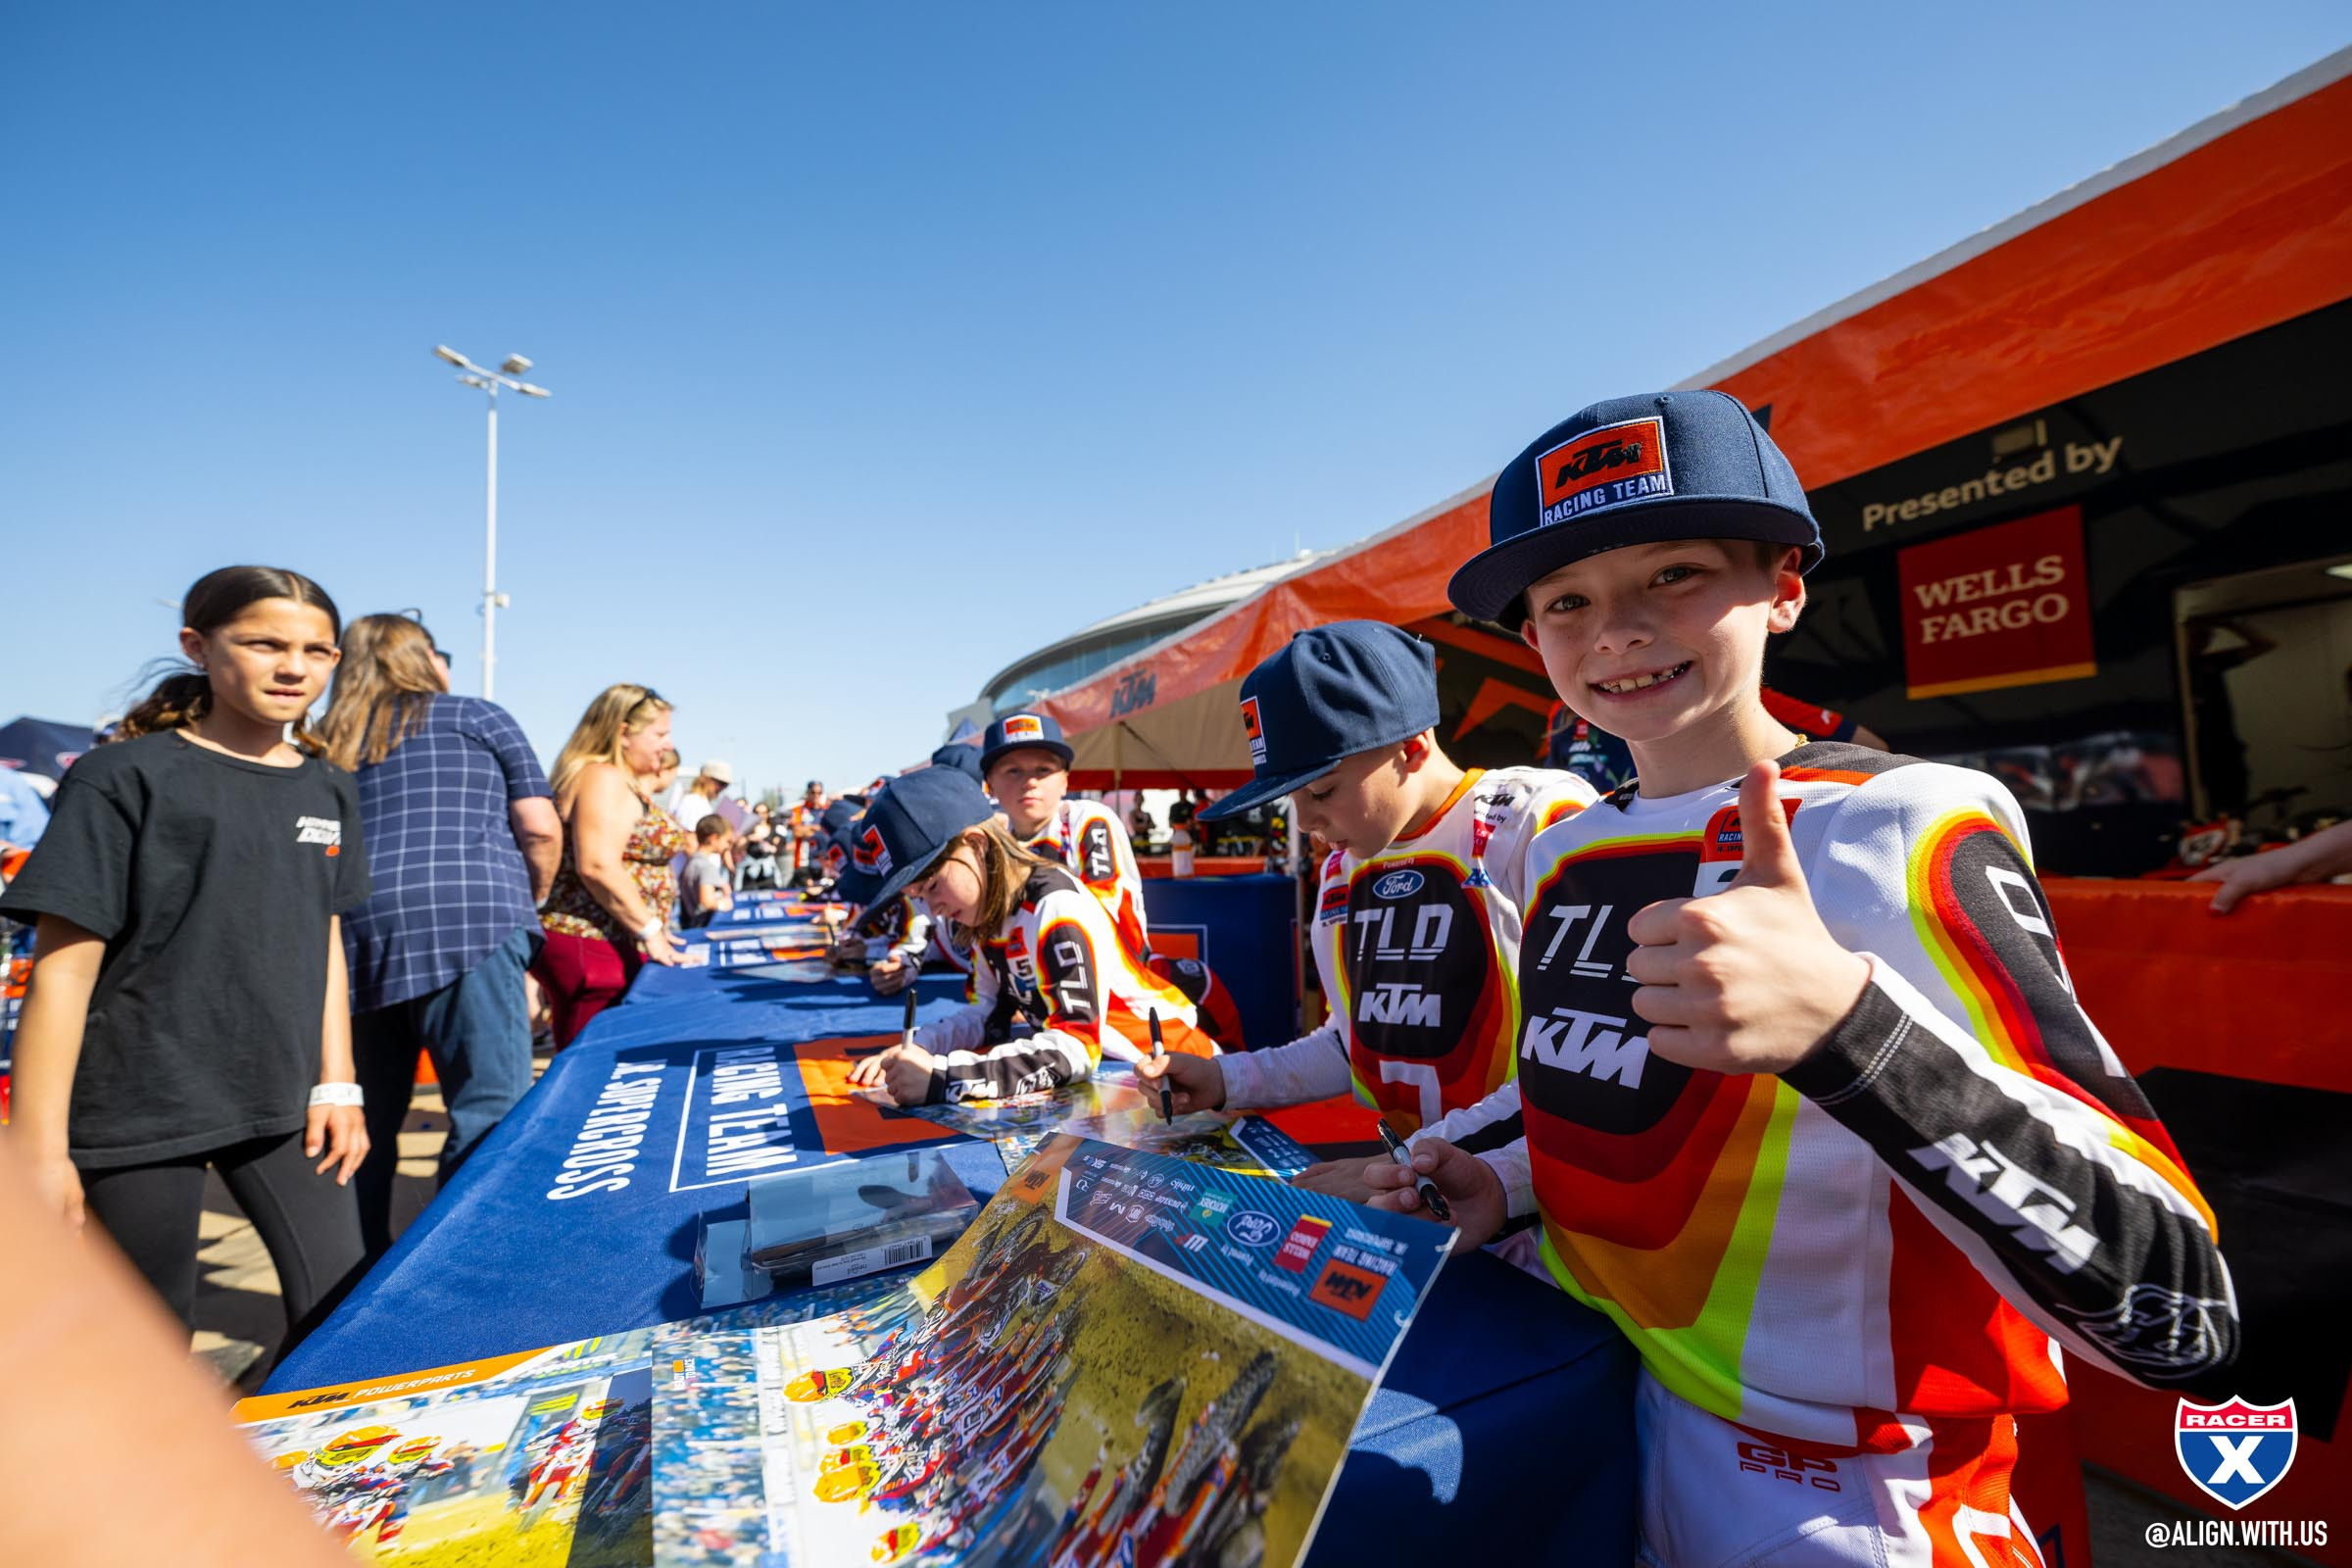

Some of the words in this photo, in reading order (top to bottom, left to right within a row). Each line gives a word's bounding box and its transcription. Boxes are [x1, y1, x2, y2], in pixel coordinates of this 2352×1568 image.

[1555, 439, 1642, 489] KTM
[1862, 448, 2055, 531] Presented
[2064, 436, 2124, 474] by
[1544, 488, 1606, 526] RACING
[1612, 474, 1666, 500] TEAM
[1914, 555, 2065, 611] WELLS
[1920, 592, 2070, 645] FARGO
[1108, 668, 1156, 719] KTM
[1718, 832, 1743, 843] RACIN
[1382, 873, 1414, 896] Ford
[1353, 903, 1454, 962] TLD
[1537, 904, 1641, 983] TL
[1015, 957, 1033, 977] 5
[1054, 939, 1093, 1015] TLD
[1358, 983, 1443, 1029] KTM
[1520, 1006, 1651, 1090] KTM
[710, 1046, 783, 1105] RACING
[546, 1076, 663, 1200] SUPERCROSS
[706, 1102, 799, 1177] TEAM
[1234, 1214, 1273, 1243] Ford
[1907, 1132, 2100, 1277] KTM
[1282, 1243, 1312, 1261] WELLS
[1332, 1244, 1358, 1265] TEAM
[1355, 1250, 1398, 1277] RACING
[1324, 1270, 1372, 1302] KTM
[286, 1392, 350, 1409] KTM
[353, 1369, 477, 1399] POWERPARTS
[684, 1358, 696, 1371] RACE
[1737, 1442, 1838, 1473] GP
[1740, 1460, 1841, 1493] PRO
